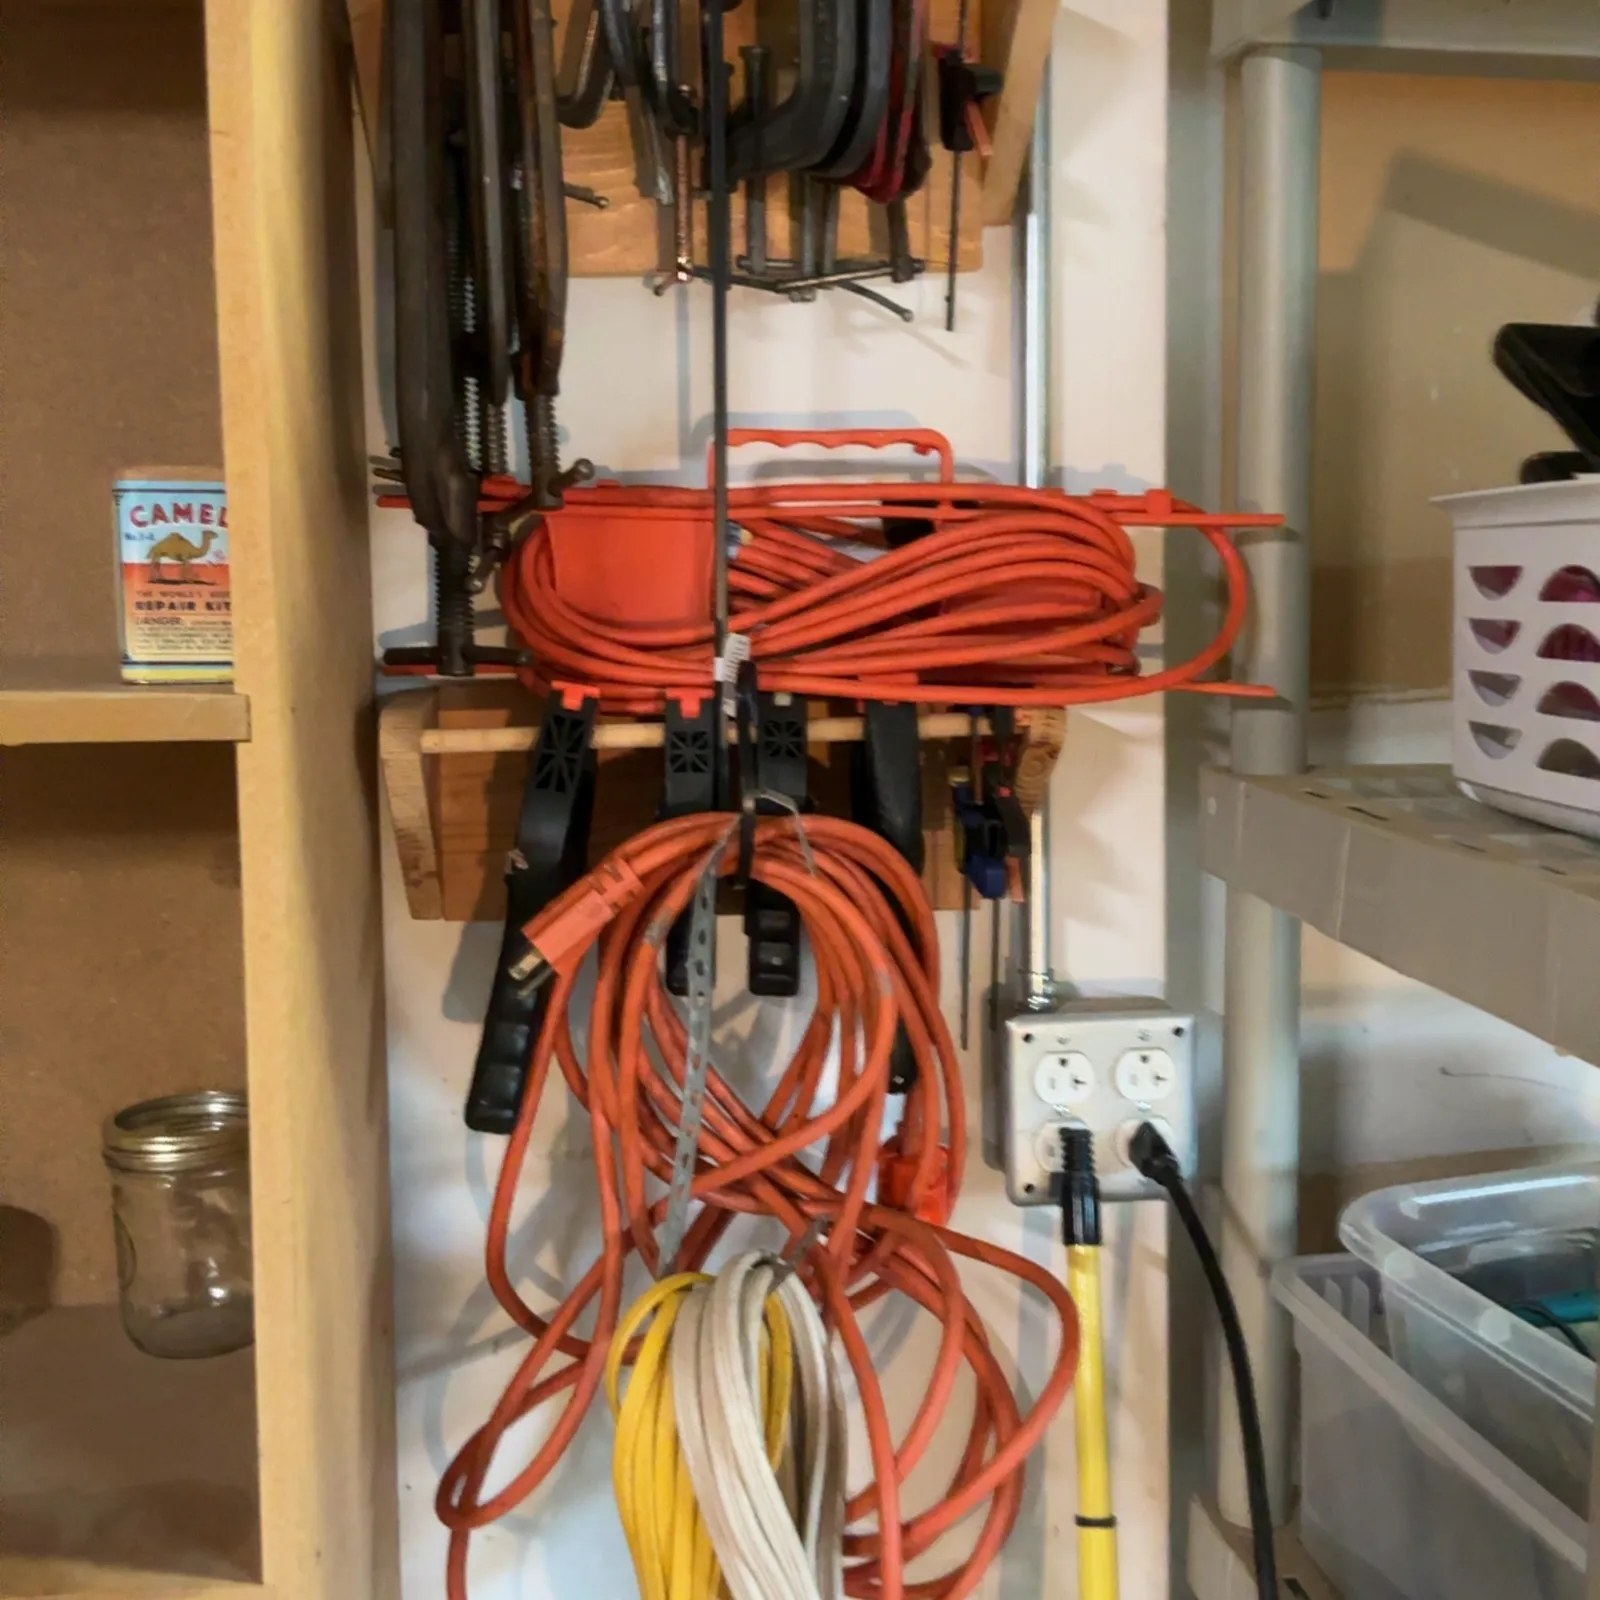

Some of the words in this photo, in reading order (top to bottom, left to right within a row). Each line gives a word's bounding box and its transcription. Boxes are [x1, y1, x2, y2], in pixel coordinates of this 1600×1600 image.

[130, 503, 228, 528] CAMEL
[135, 601, 196, 611] REPAIR
[205, 601, 231, 611] KIT
